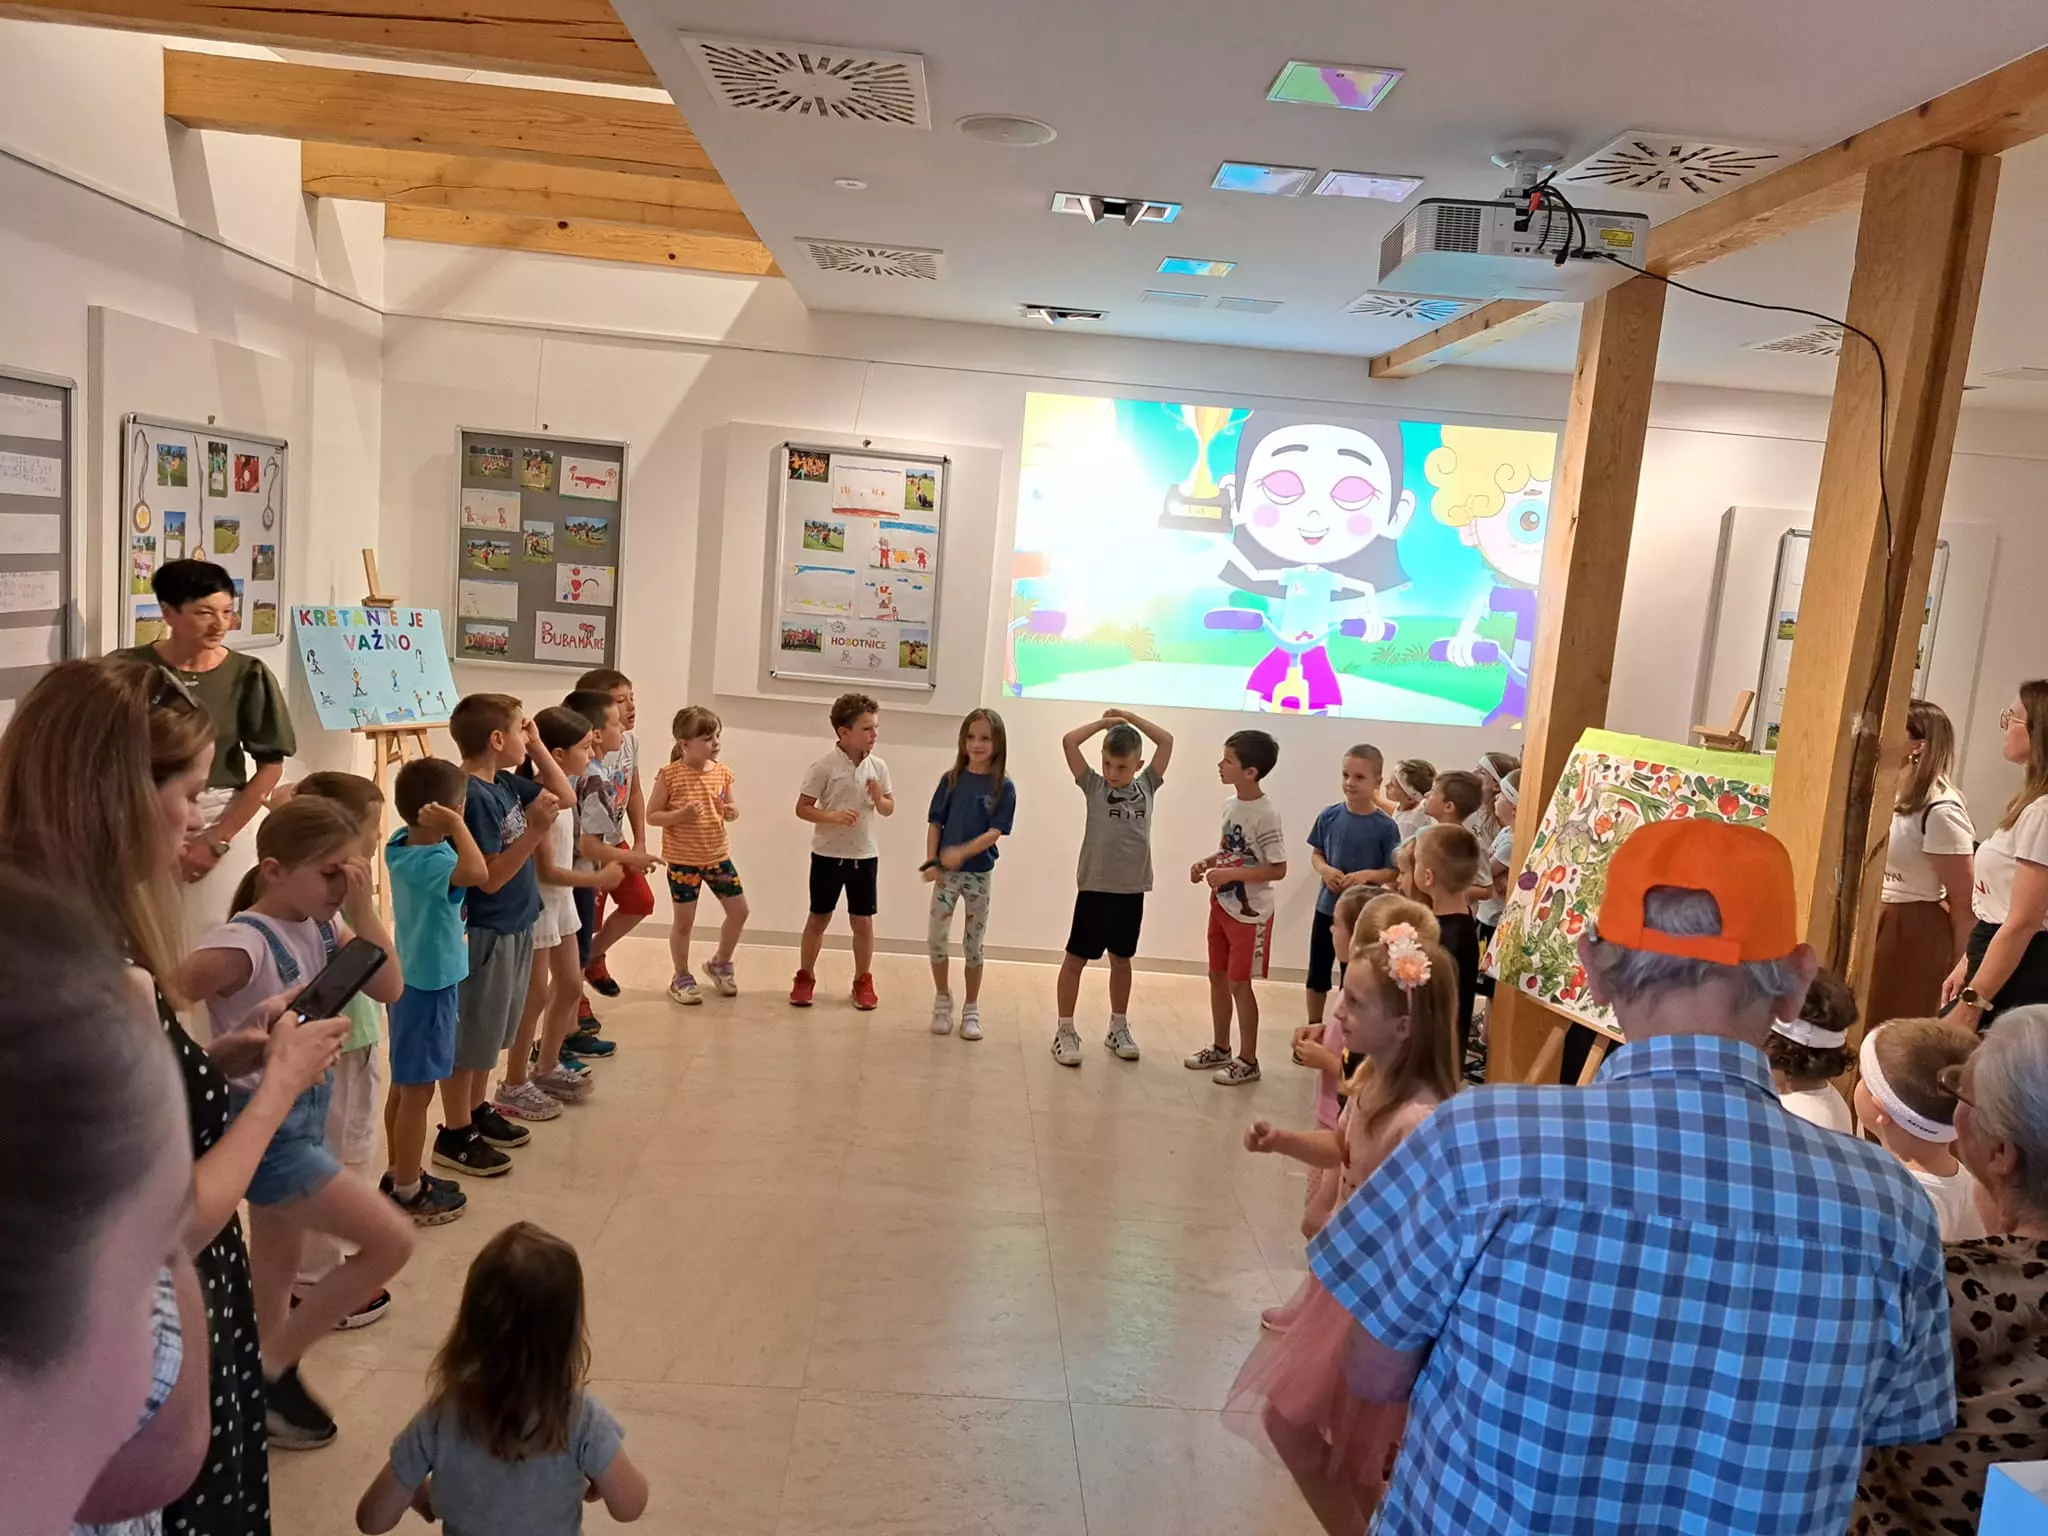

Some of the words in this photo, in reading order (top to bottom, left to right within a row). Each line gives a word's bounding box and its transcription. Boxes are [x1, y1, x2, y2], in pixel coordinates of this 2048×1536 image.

[299, 609, 399, 628] KRETANJE
[409, 611, 424, 628] JE
[343, 628, 411, 651] VAŽNO
[541, 621, 605, 650] BUBAMARE
[1109, 809, 1145, 820] AIR
